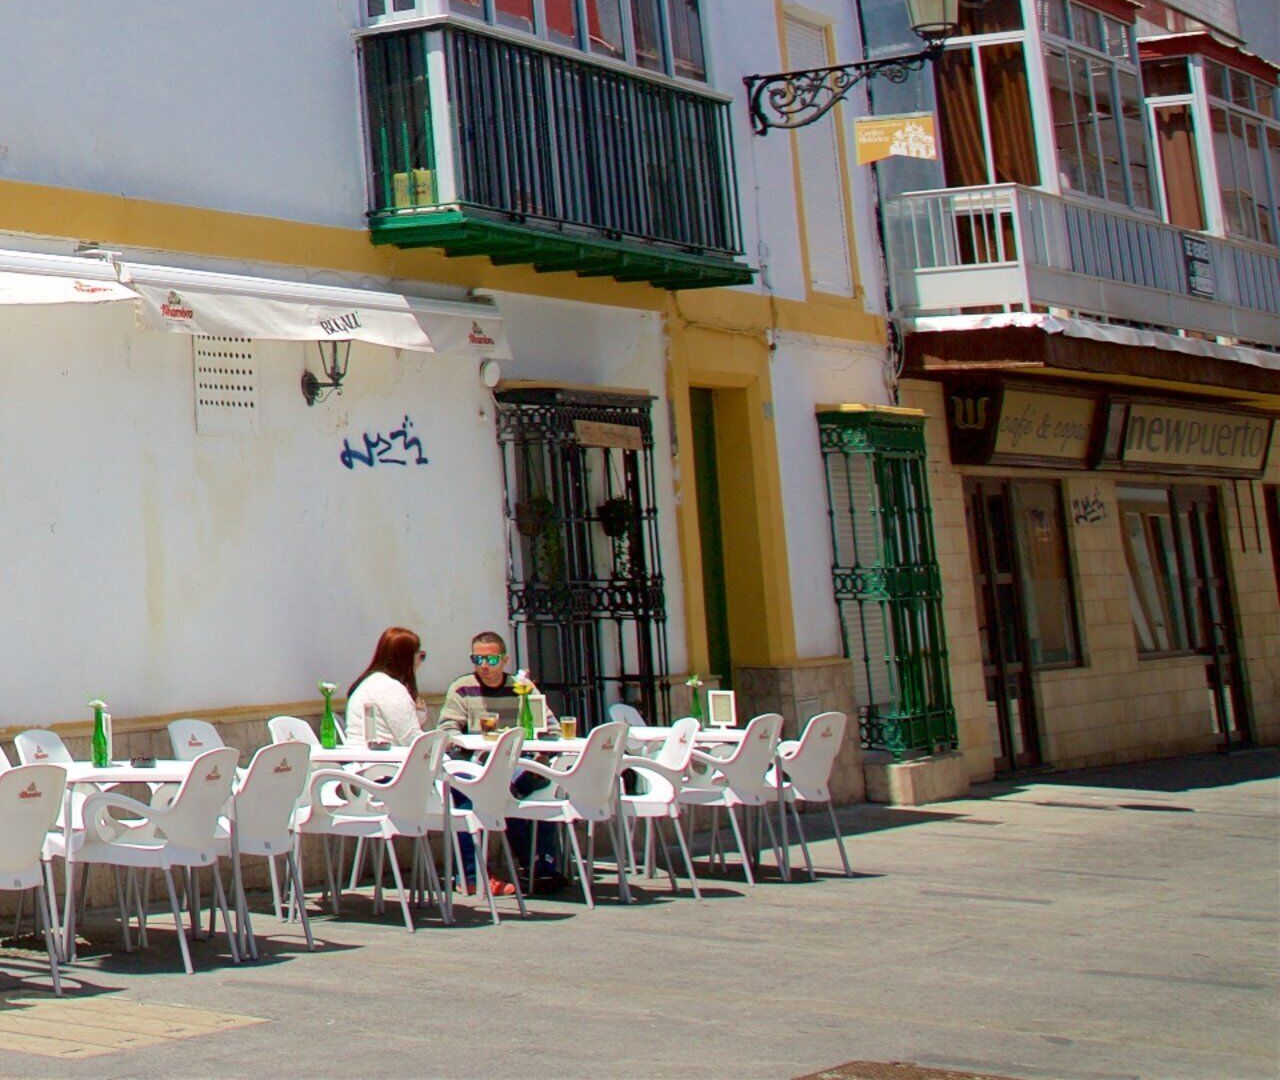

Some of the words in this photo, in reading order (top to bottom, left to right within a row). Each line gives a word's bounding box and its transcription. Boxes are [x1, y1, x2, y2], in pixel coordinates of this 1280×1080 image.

[161, 303, 194, 320] Alhambra
[999, 403, 1033, 448] café
[1036, 412, 1051, 440] &
